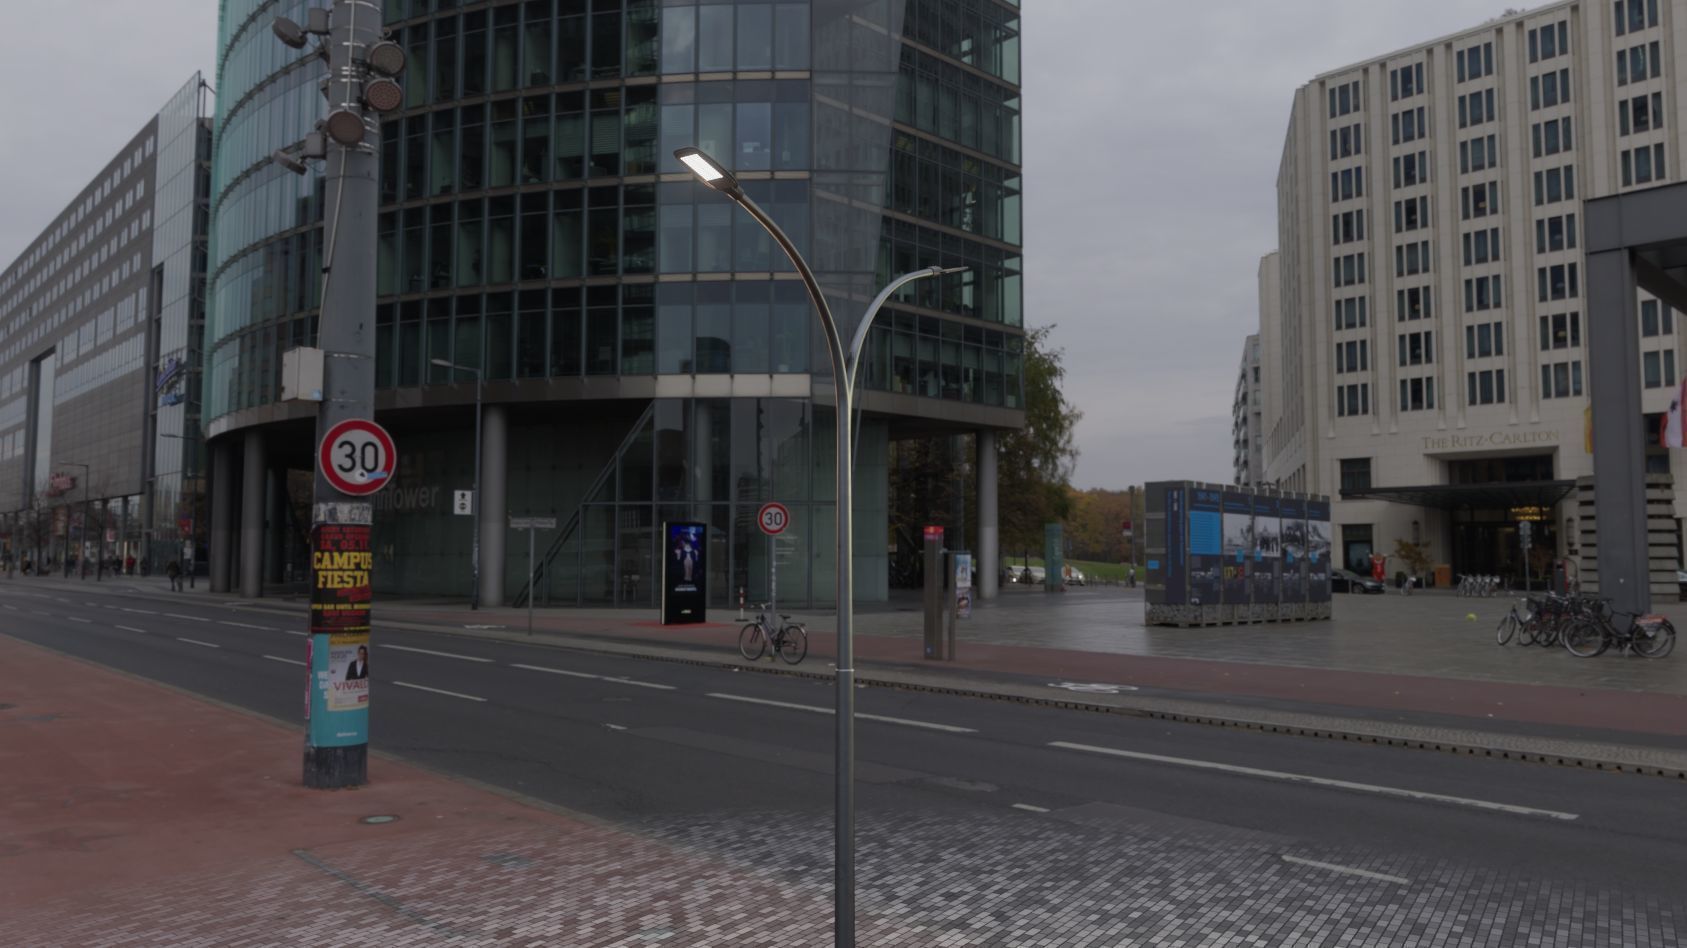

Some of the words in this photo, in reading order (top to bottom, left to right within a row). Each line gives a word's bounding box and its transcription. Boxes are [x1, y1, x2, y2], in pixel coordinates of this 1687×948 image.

[1422, 436, 1449, 449] THE
[337, 441, 379, 473] 30
[764, 511, 783, 526] 30
[313, 551, 373, 570] CAMPUS
[317, 570, 369, 588] FIESTA
